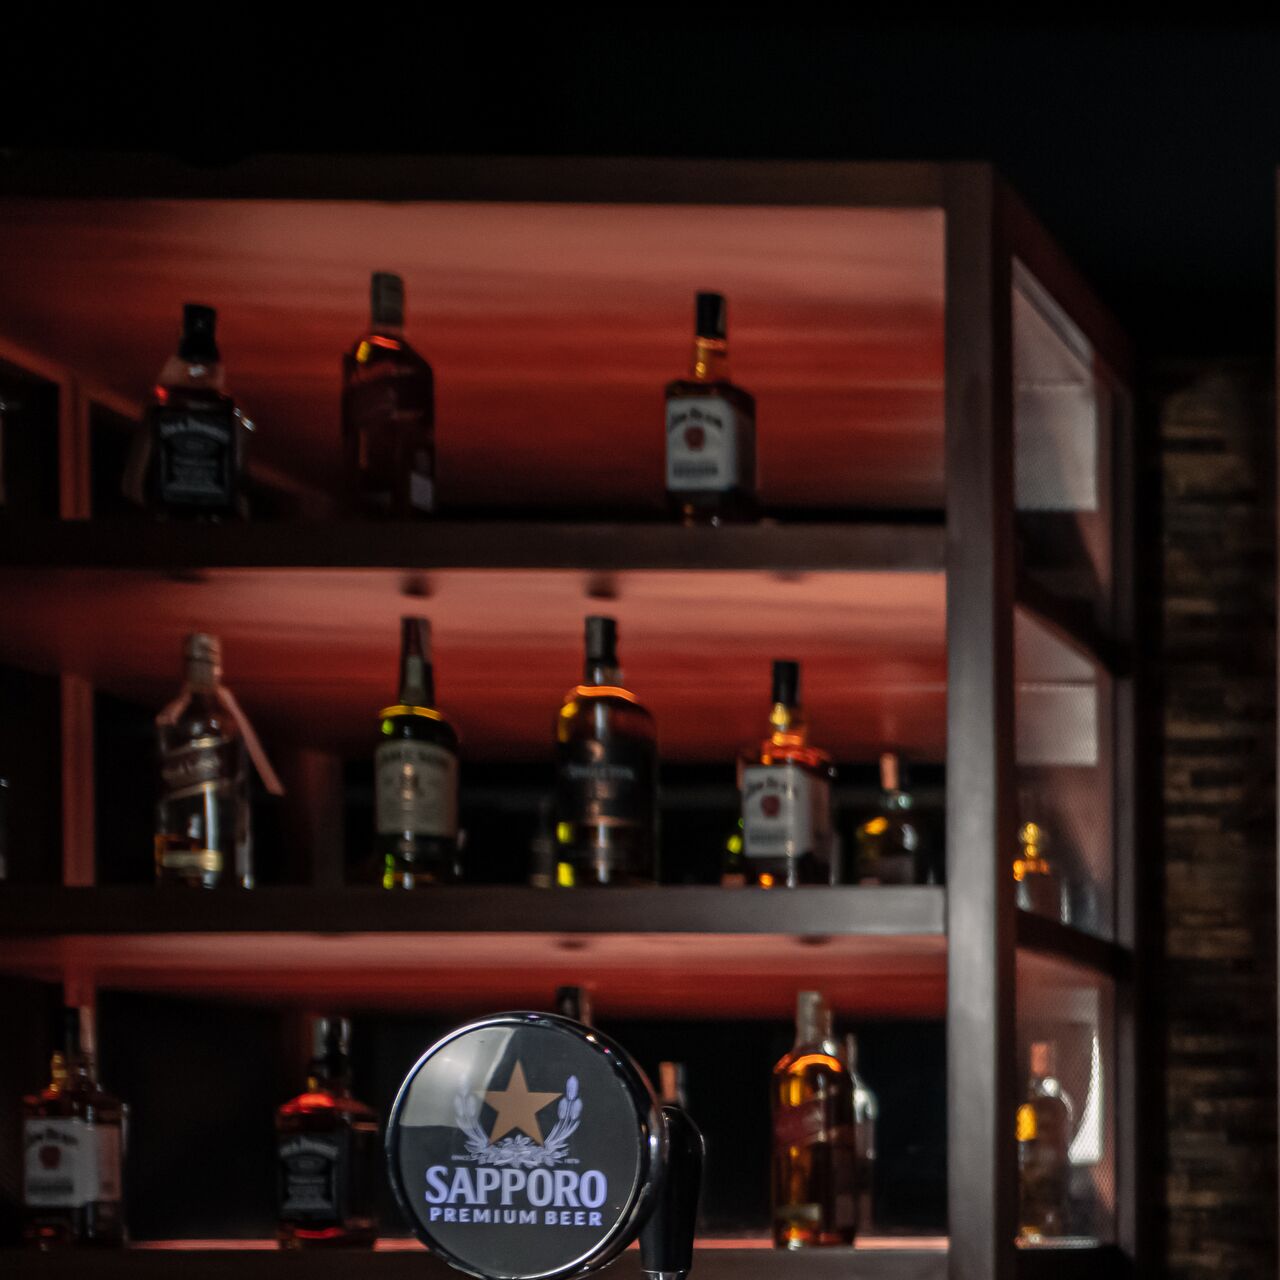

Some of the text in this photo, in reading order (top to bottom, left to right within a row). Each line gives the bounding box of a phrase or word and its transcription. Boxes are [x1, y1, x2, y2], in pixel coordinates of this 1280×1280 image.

[425, 1165, 608, 1209] SAPPORO
[429, 1206, 603, 1227] PREMIUM BEER
